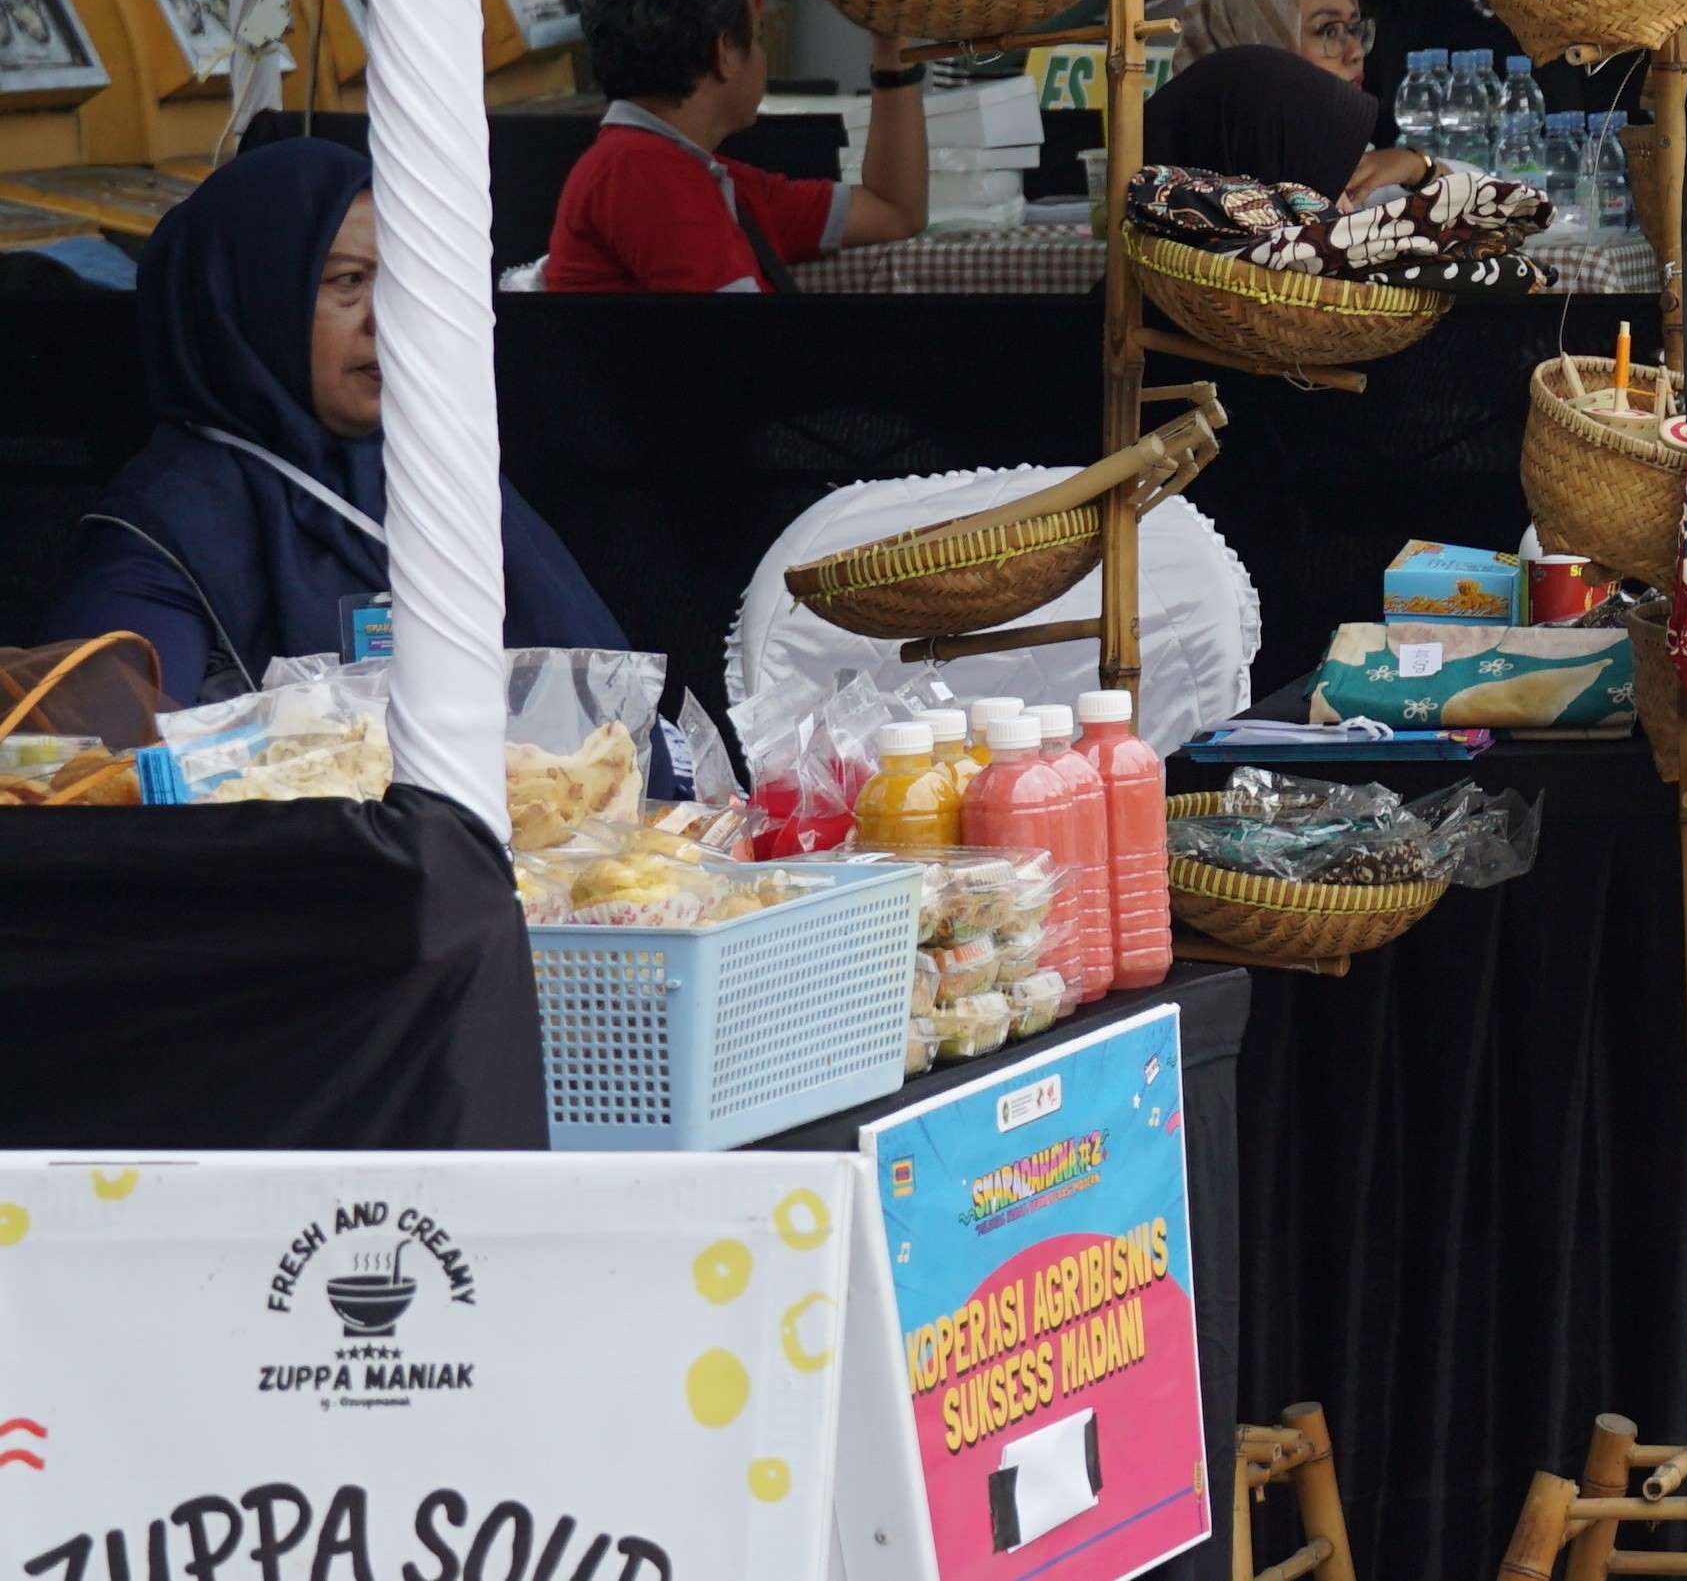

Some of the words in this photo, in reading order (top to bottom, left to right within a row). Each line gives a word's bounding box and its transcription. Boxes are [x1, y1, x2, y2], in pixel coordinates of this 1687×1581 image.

[1040, 55, 1094, 110] ES
[267, 1221, 328, 1314] FRESH
[335, 1201, 389, 1235] AND
[397, 1208, 477, 1306] CREAMY
[906, 1278, 1028, 1396] KOPERASI
[1033, 1216, 1170, 1340] AGRIBISNIS
[258, 1364, 353, 1392] ZUPPA
[364, 1362, 475, 1391] MANIAK
[942, 1340, 1055, 1455] SUKSESS
[1060, 1296, 1146, 1398] MADANI
